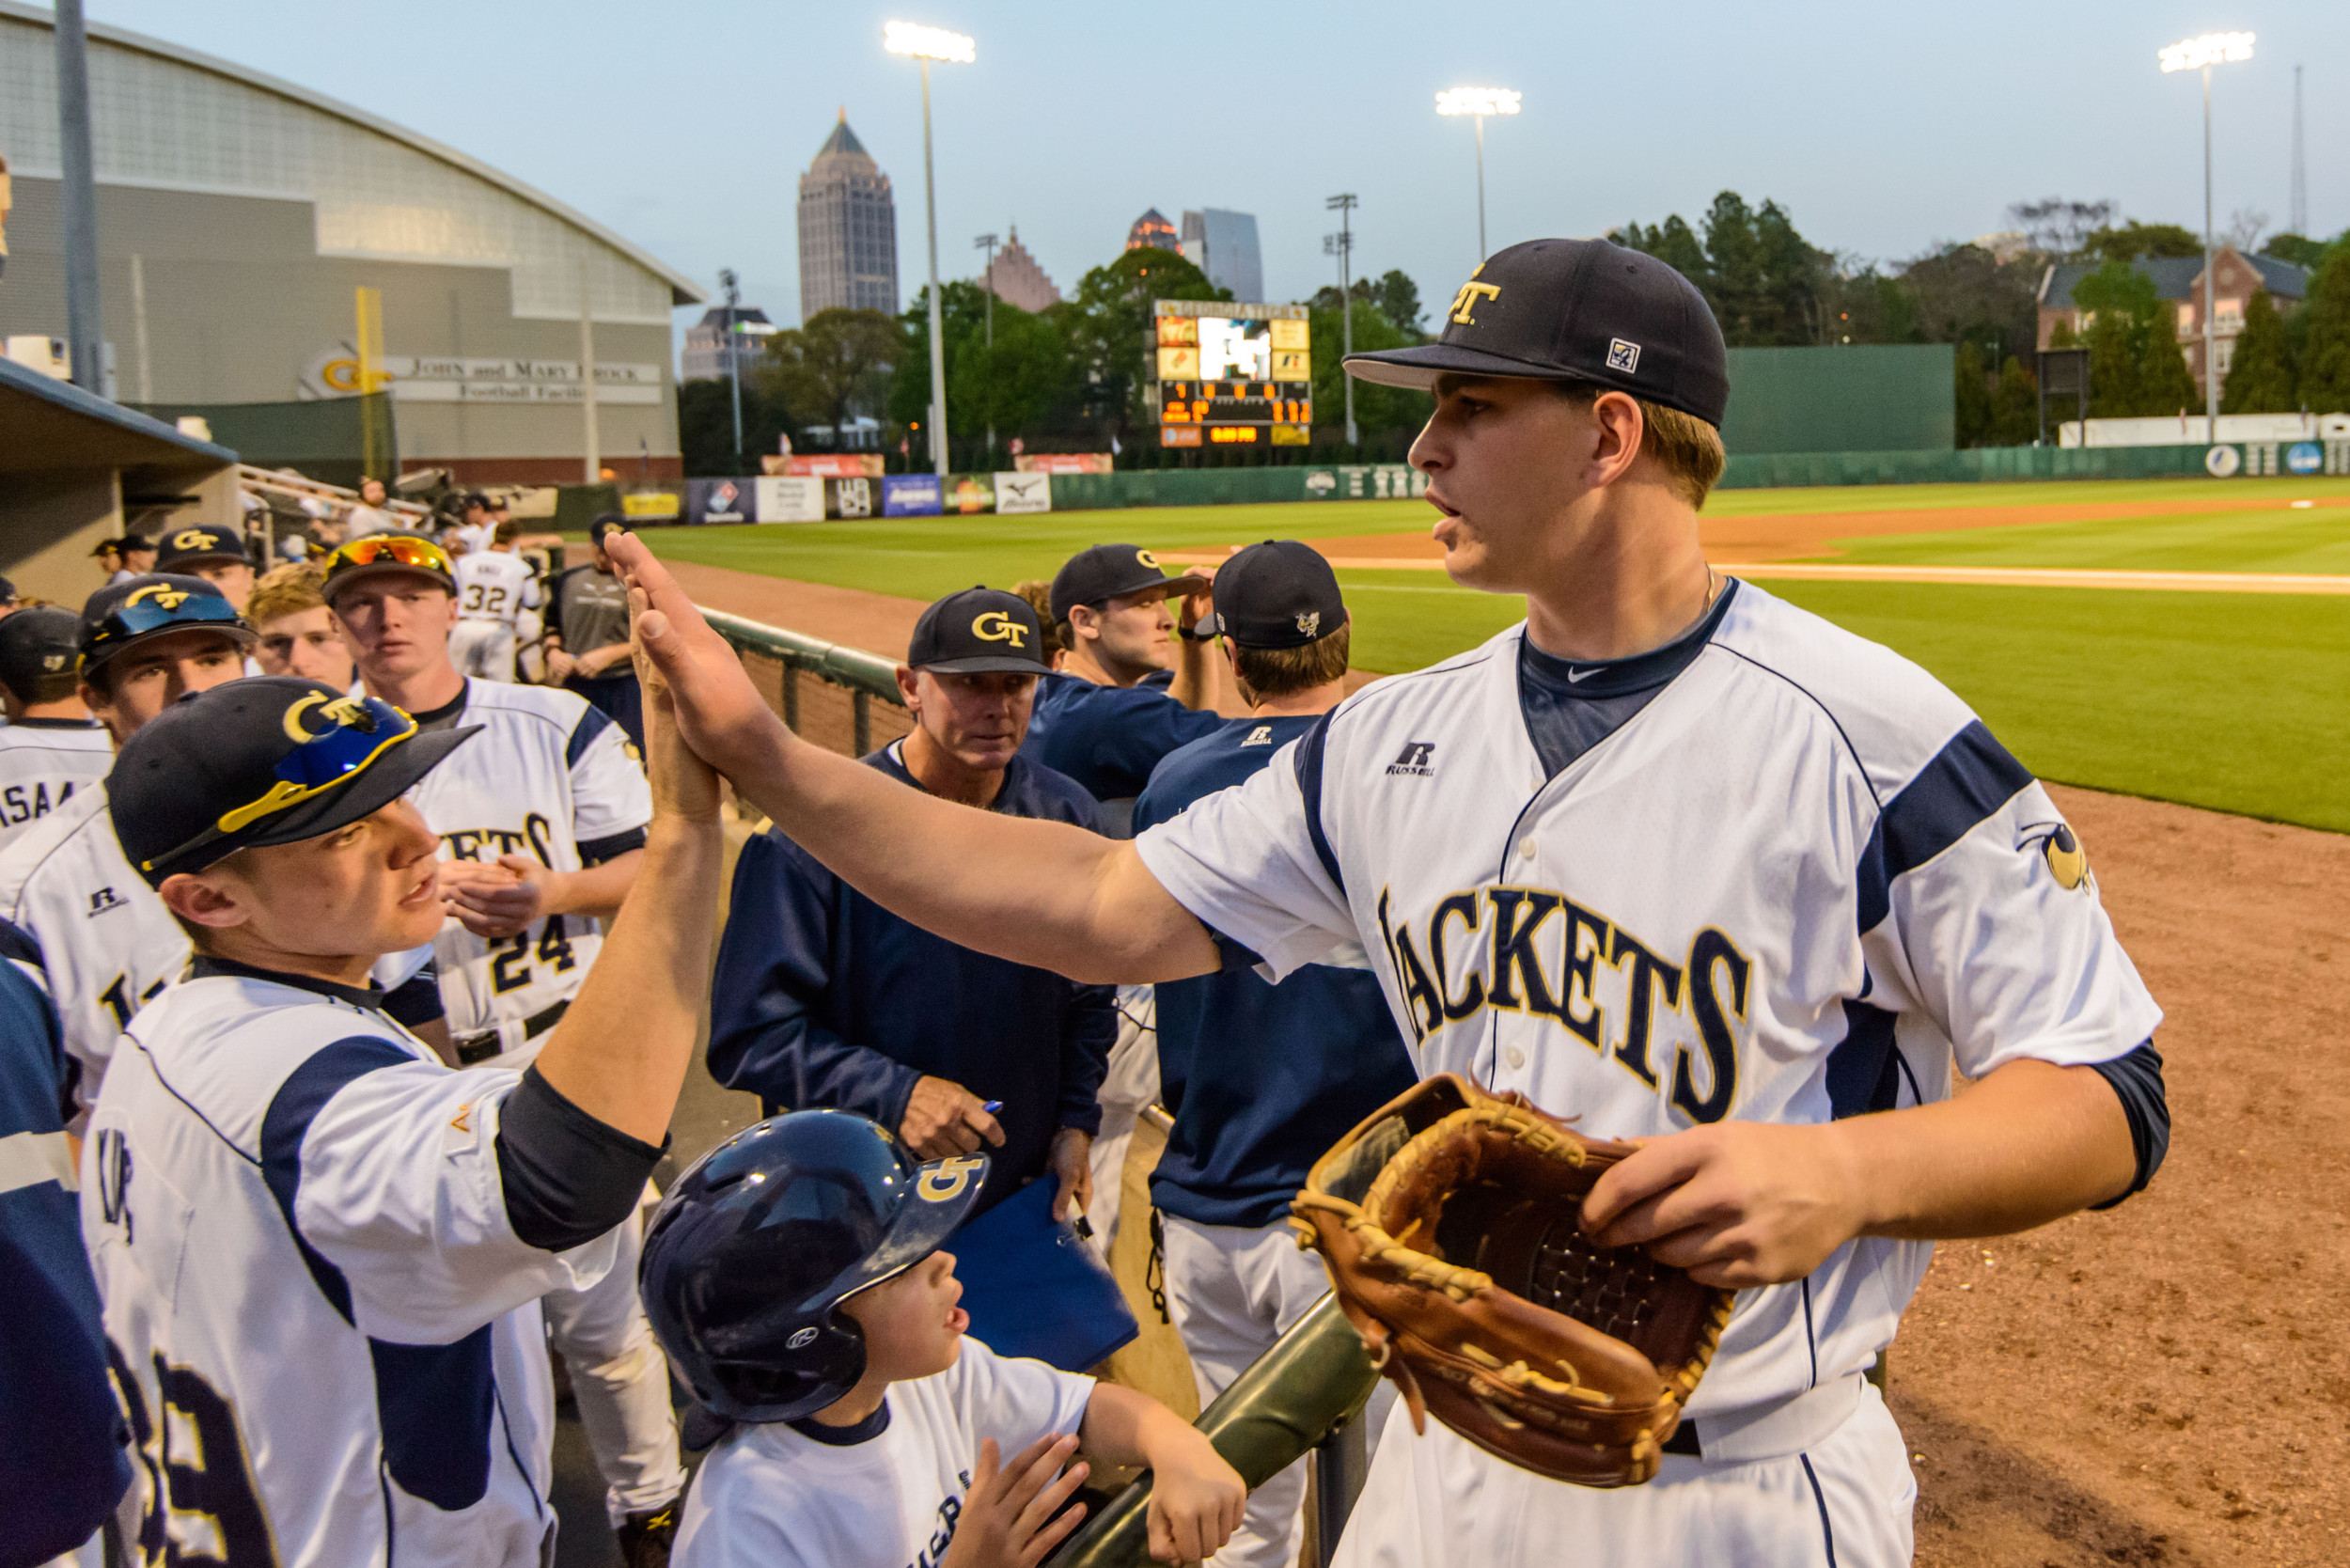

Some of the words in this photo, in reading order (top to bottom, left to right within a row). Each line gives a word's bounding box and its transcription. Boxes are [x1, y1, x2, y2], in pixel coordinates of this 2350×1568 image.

[577, 365, 637, 378] ROCK
[173, 529, 219, 551] GT
[463, 584, 506, 614] 32
[971, 611, 1029, 649] GT
[486, 912, 577, 997] 24
[1377, 883, 1753, 1125] JACKETS
[916, 1156, 984, 1202] GT
